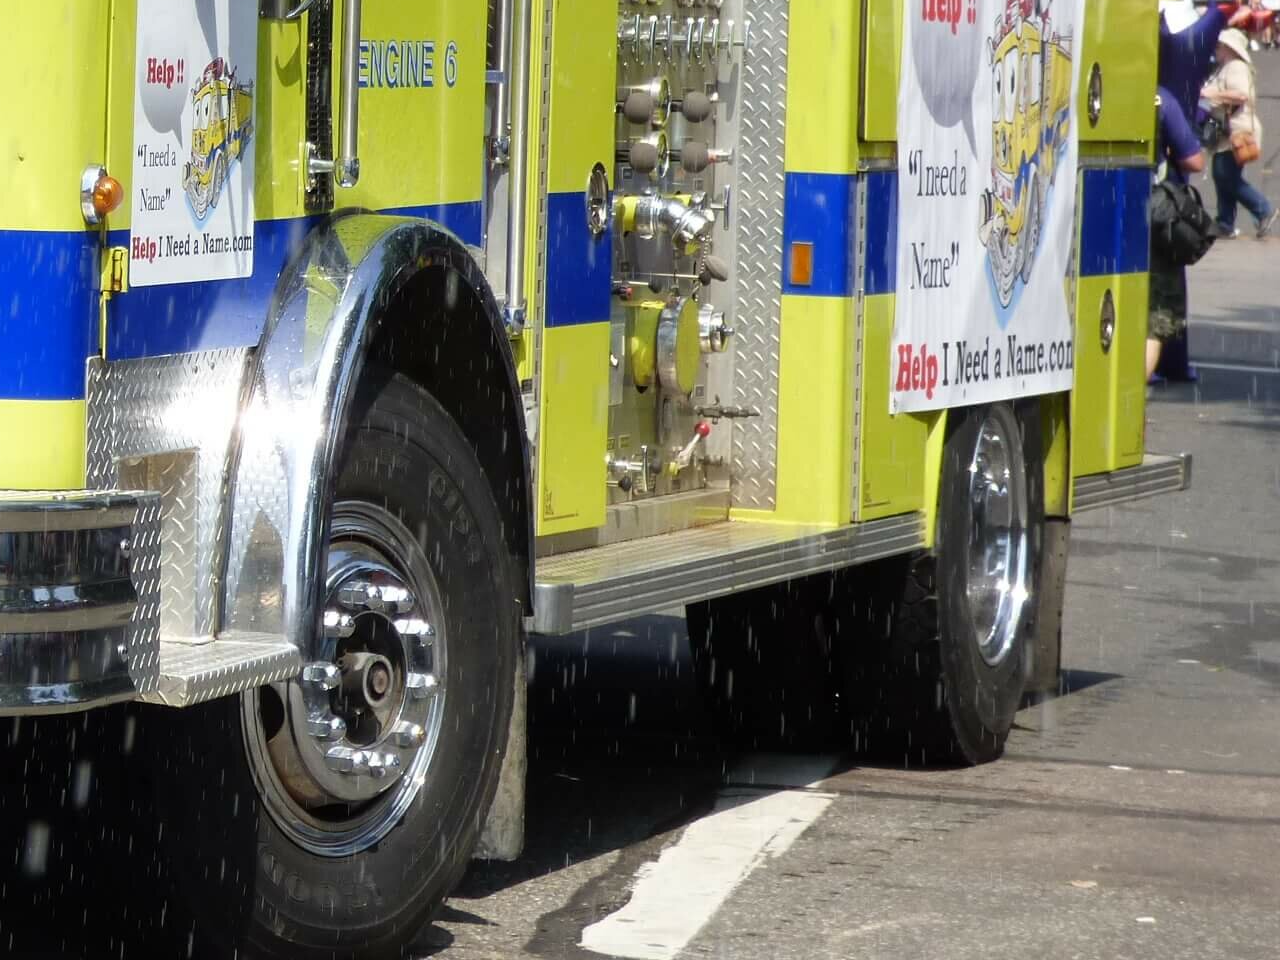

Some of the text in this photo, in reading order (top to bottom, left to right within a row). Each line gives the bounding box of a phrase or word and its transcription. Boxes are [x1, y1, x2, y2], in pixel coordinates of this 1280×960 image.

[147, 58, 184, 89] Help !!
[357, 40, 458, 88] ENGINE 6
[149, 144, 170, 166] need
[171, 151, 176, 166] a
[925, 150, 958, 195] need
[959, 166, 967, 195] a
[131, 233, 252, 263] Help I Need a Name.com
[896, 343, 939, 400] Help
[942, 342, 950, 386] I
[955, 337, 990, 385] Need
[994, 348, 1001, 378] a
